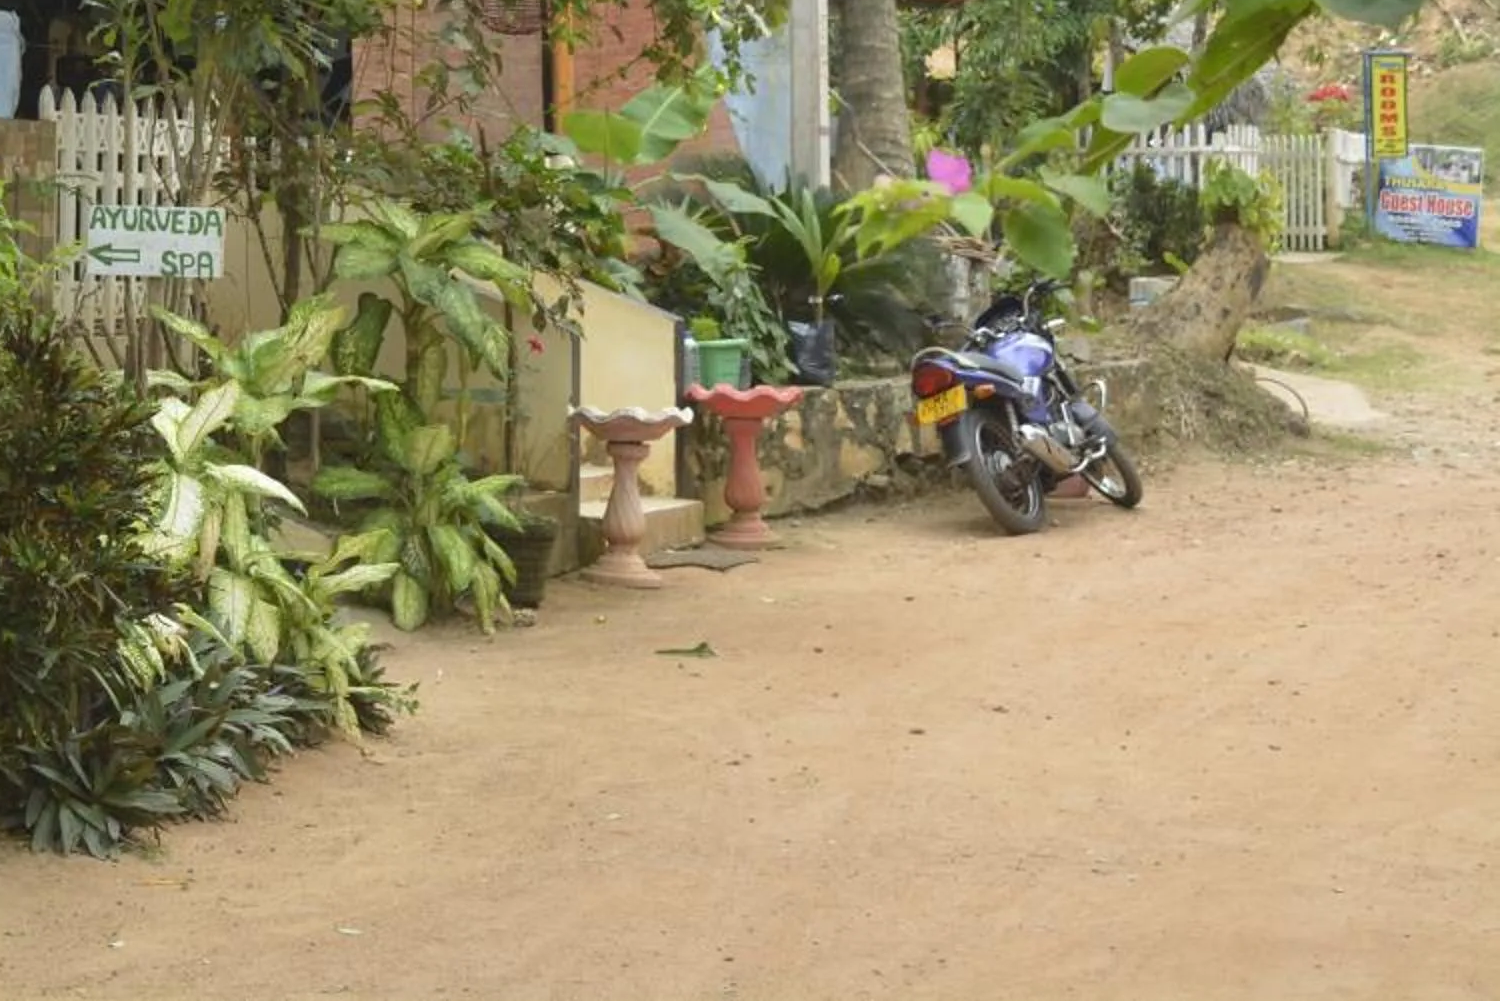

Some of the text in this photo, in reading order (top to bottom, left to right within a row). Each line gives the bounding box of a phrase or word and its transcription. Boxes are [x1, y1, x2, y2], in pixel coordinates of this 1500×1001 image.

[1380, 190, 1474, 216] Guest House
[89, 206, 222, 237] AYURVEDA
[160, 250, 214, 281] SPA
